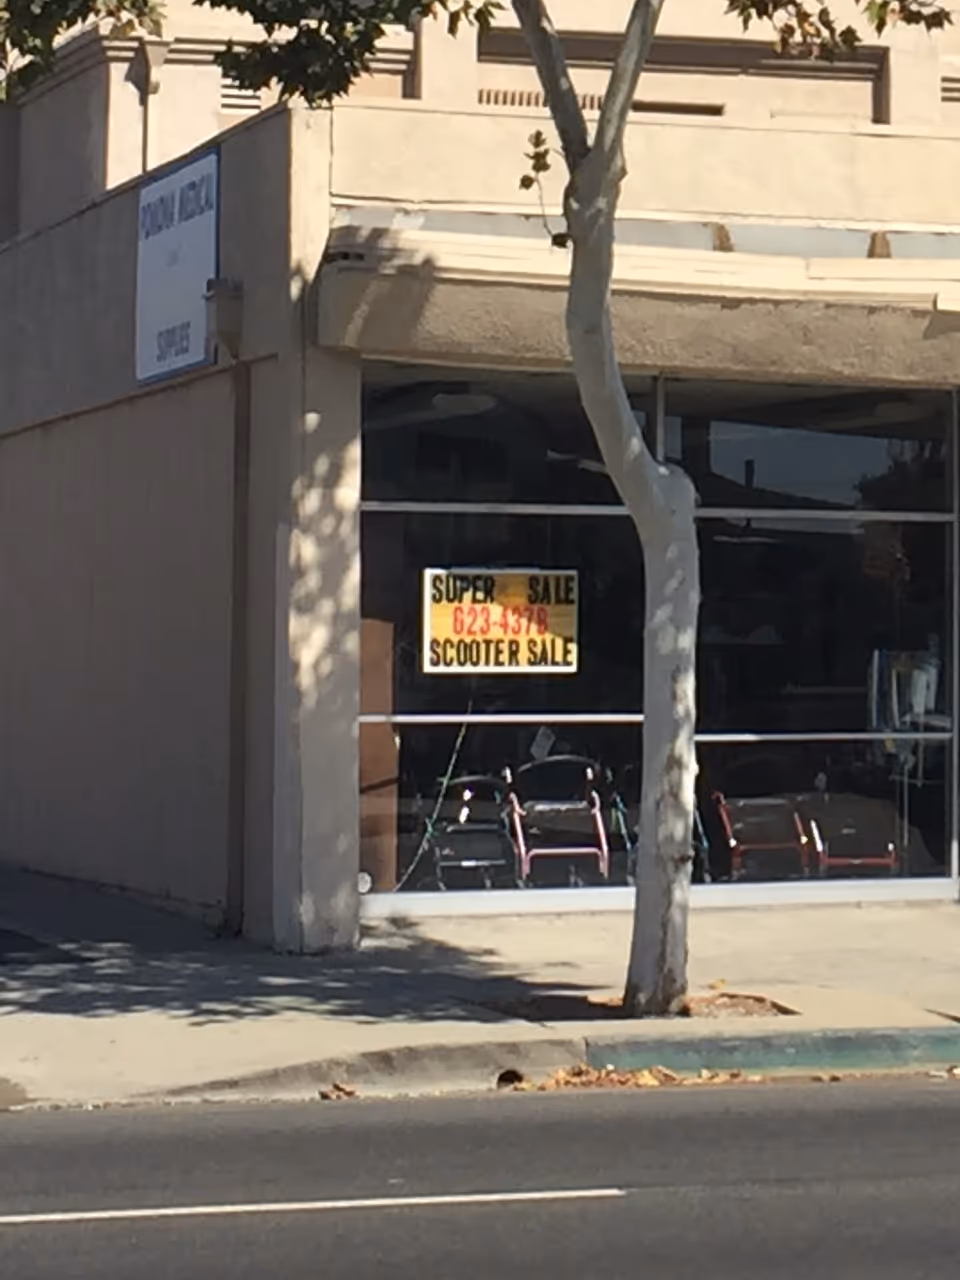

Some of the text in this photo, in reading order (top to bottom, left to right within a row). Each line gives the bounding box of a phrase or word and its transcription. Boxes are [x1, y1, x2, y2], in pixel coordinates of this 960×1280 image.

[431, 575, 575, 604] SUPER SALE
[430, 637, 574, 667] SCOOTER SALE
